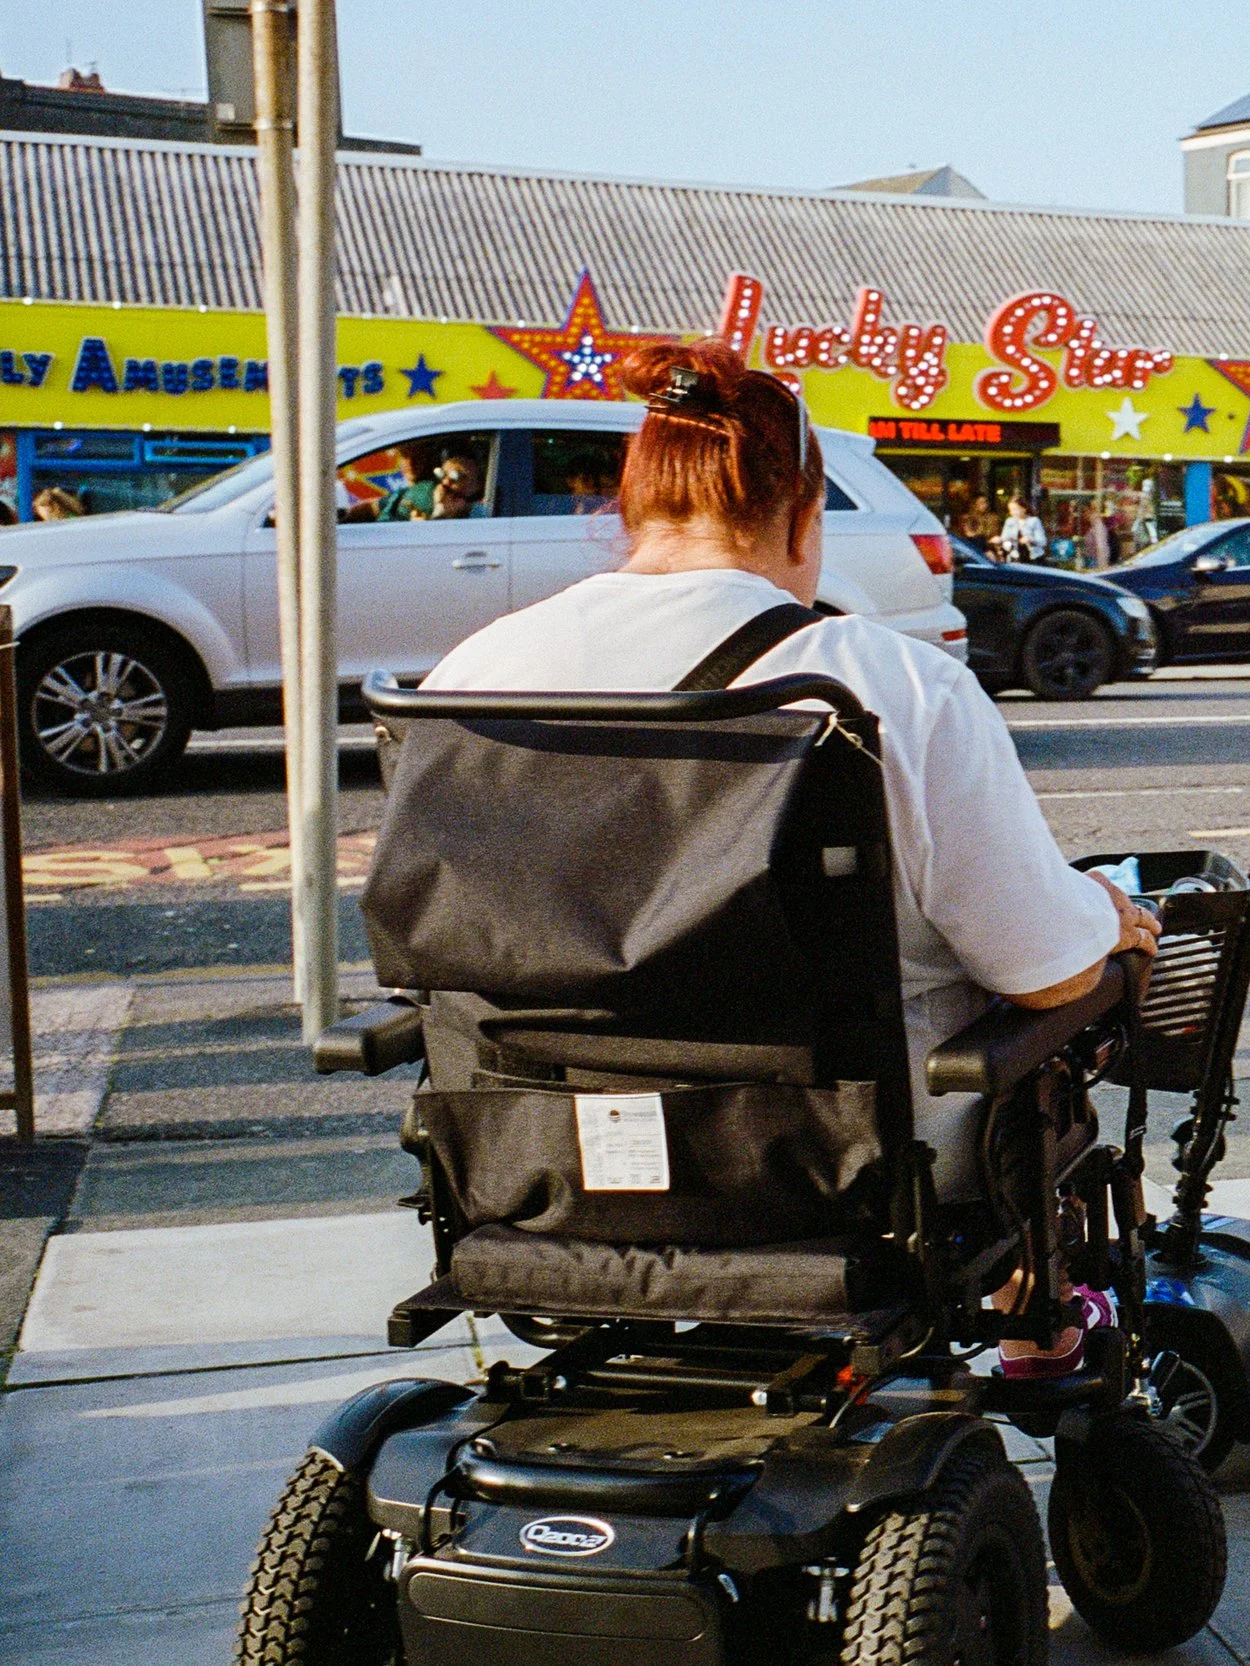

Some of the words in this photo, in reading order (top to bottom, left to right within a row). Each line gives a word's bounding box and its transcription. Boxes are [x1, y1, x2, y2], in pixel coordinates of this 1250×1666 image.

[70, 336, 384, 399] AMUSEMTS
[728, 274, 949, 412] Lucky
[975, 290, 1174, 414] Star
[899, 421, 945, 441] TILL
[947, 423, 1001, 443] LATE
